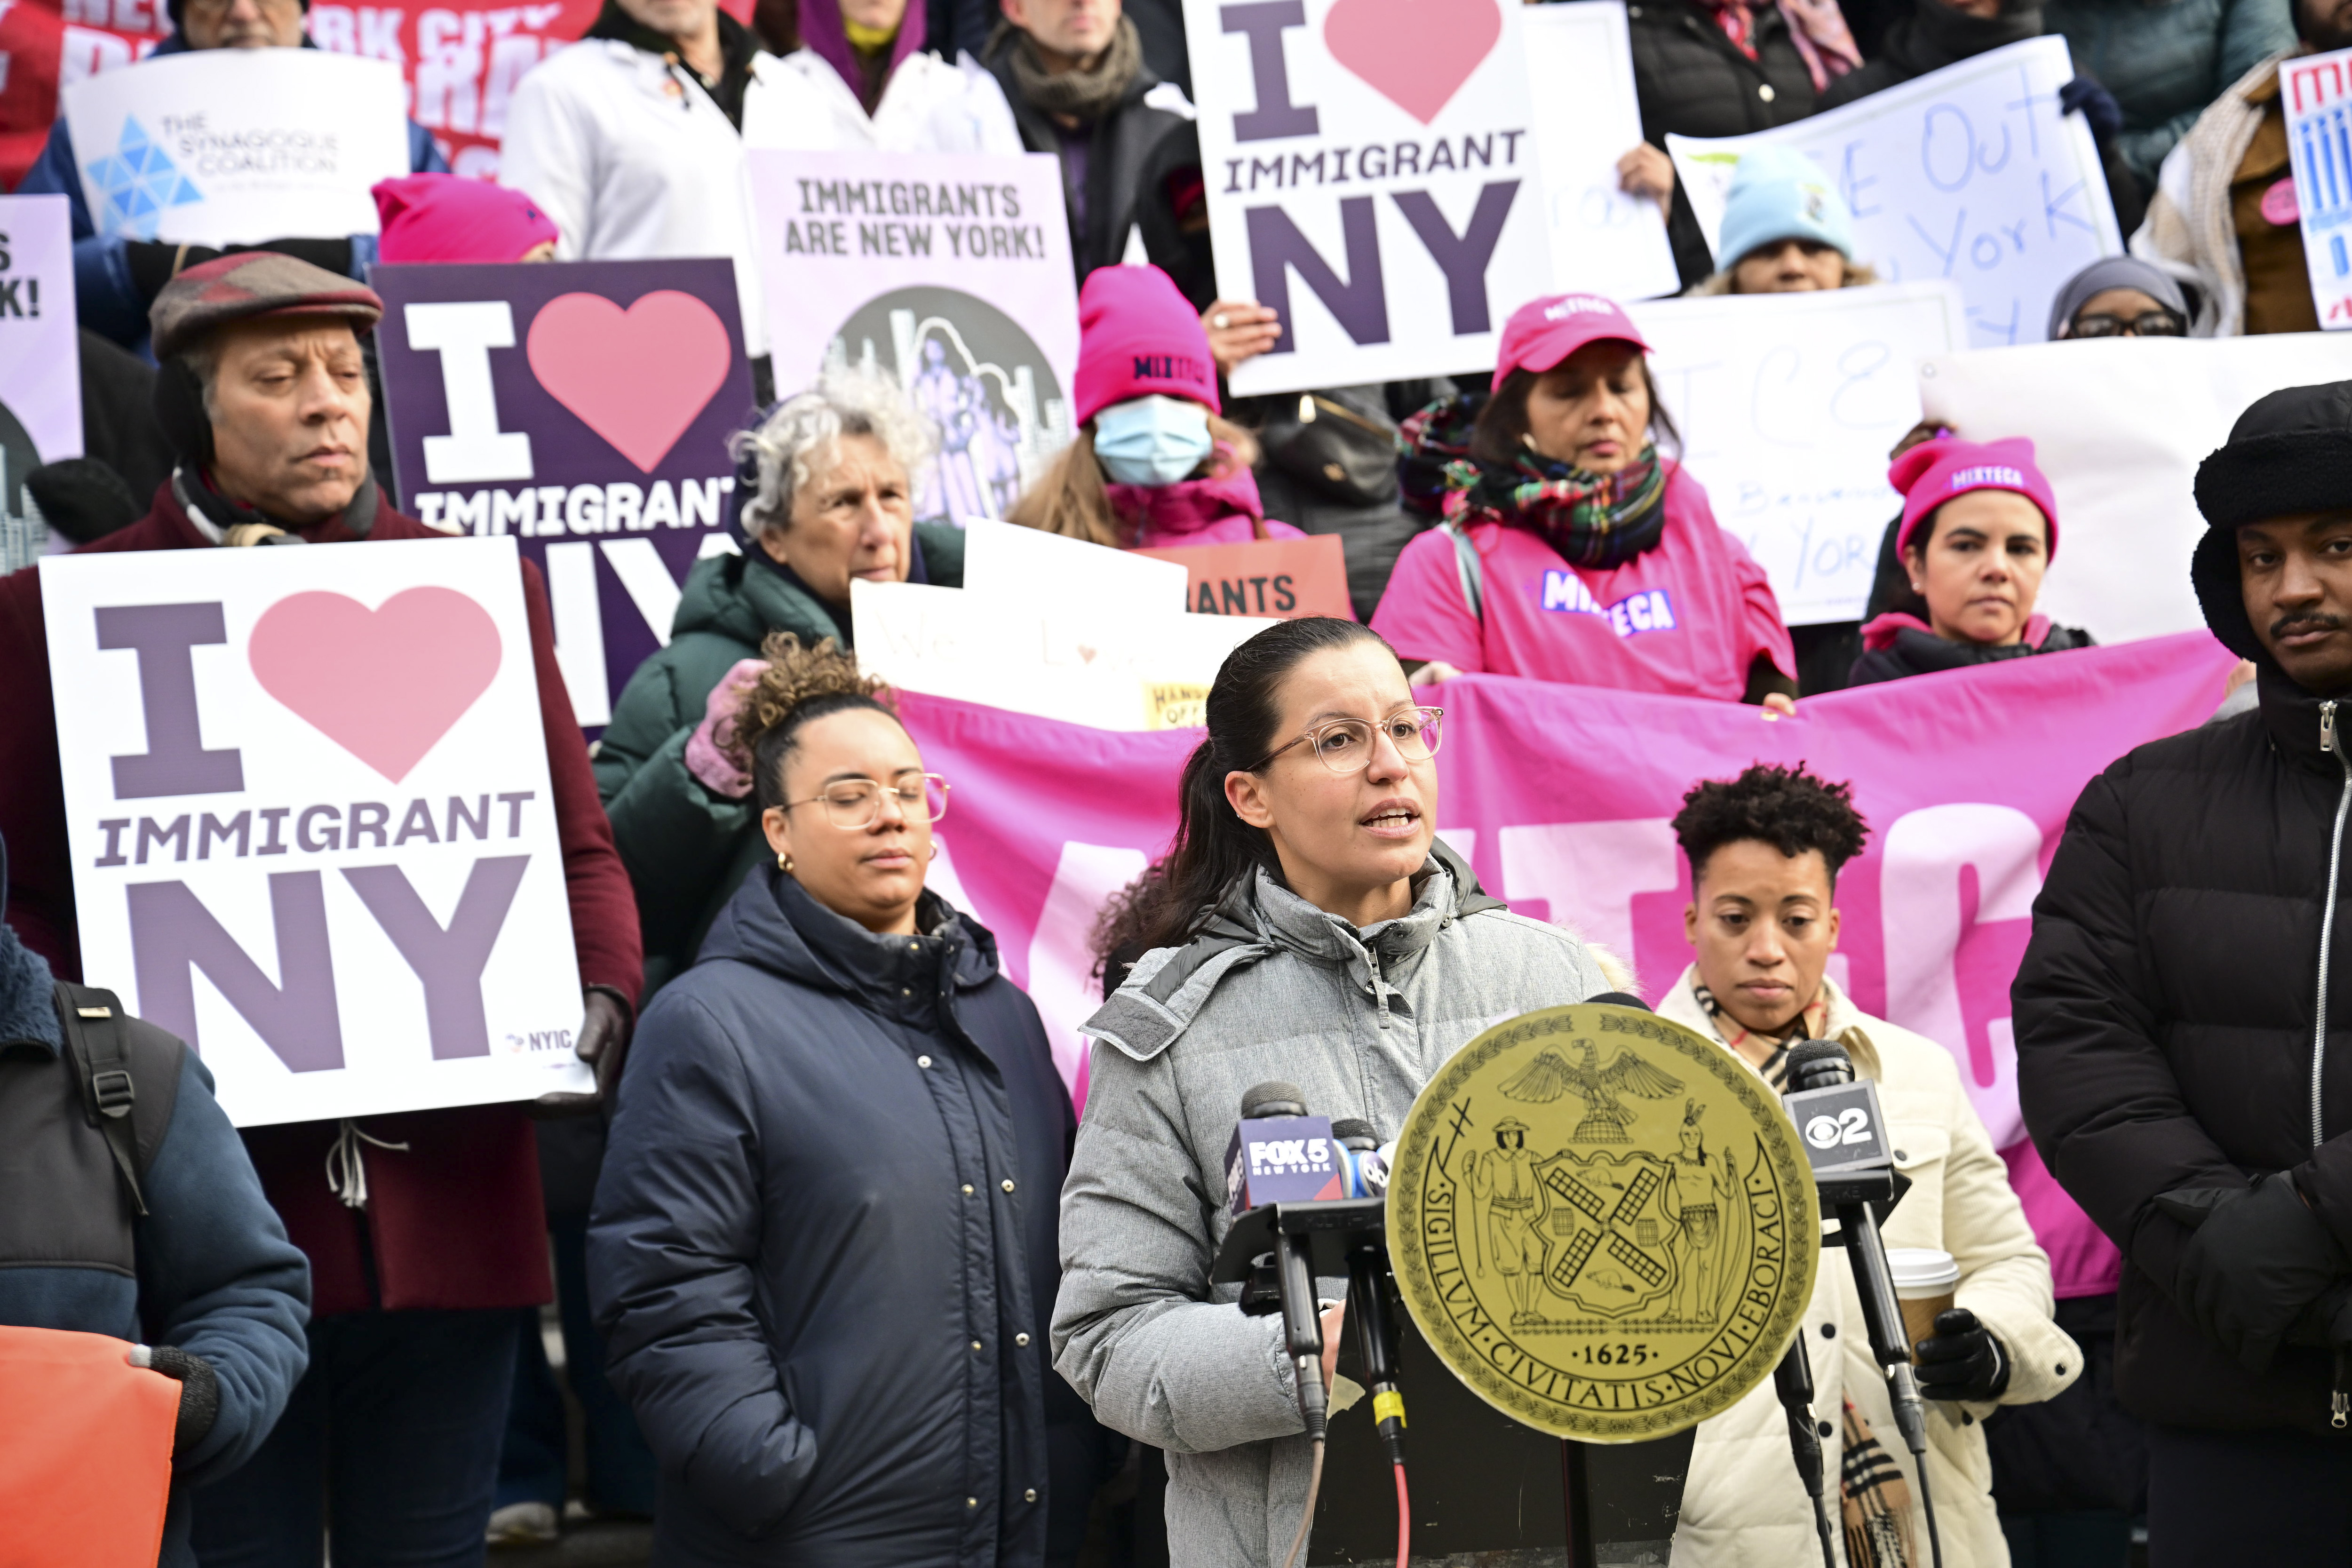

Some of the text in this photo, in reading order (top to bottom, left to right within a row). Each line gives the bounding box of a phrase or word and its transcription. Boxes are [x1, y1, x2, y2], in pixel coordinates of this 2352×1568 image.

[1220, 0, 1320, 143] I
[162, 111, 206, 136] THE
[178, 128, 340, 159] SYNAGOGUE
[196, 149, 338, 178] COALITION
[1224, 128, 1526, 193] IMMIGRANT
[796, 179, 1020, 218] IMMIGRANTS
[785, 220, 1046, 260] ARE NEW YORK!
[1245, 178, 1522, 357] NY
[404, 301, 534, 484] I
[1186, 574, 1296, 615] ANTS
[93, 601, 245, 800] I
[94, 790, 535, 868] IMMIGRANT
[125, 854, 532, 1074] NY
[529, 1030, 572, 1051] NYIC
[1838, 1107, 1873, 1146] 2
[1252, 1162, 1332, 1176] NEW YORK
[1583, 1344, 1650, 1366] 1625
